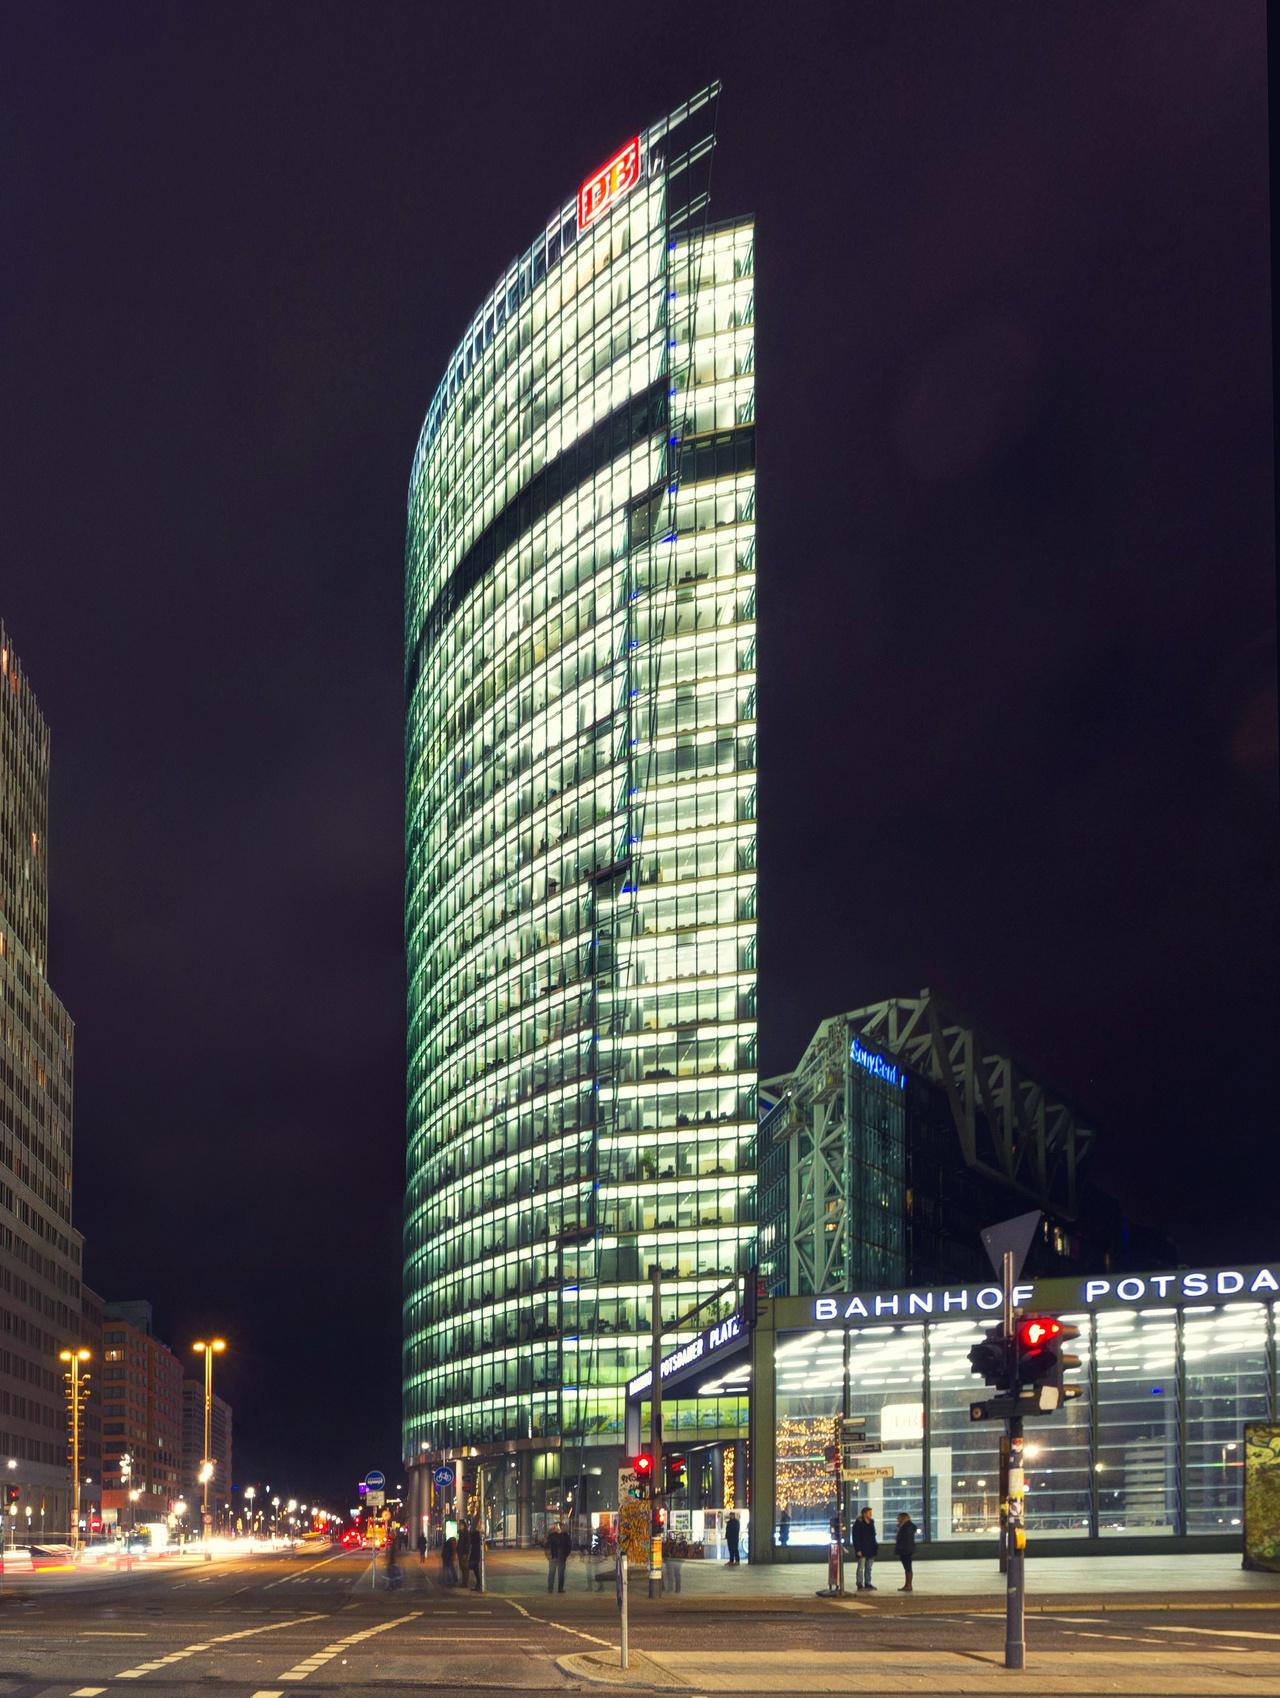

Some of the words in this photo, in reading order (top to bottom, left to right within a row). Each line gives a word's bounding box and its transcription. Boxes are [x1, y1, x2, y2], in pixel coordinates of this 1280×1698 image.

[583, 148, 636, 222] DB
[815, 1285, 1034, 1321] BAHNHOF
[1085, 1268, 1280, 1303] POTSDA
[660, 1338, 704, 1379] POTSDAMER
[709, 1314, 740, 1349] PLATZ
[847, 1469, 875, 1477] Potsdamer
